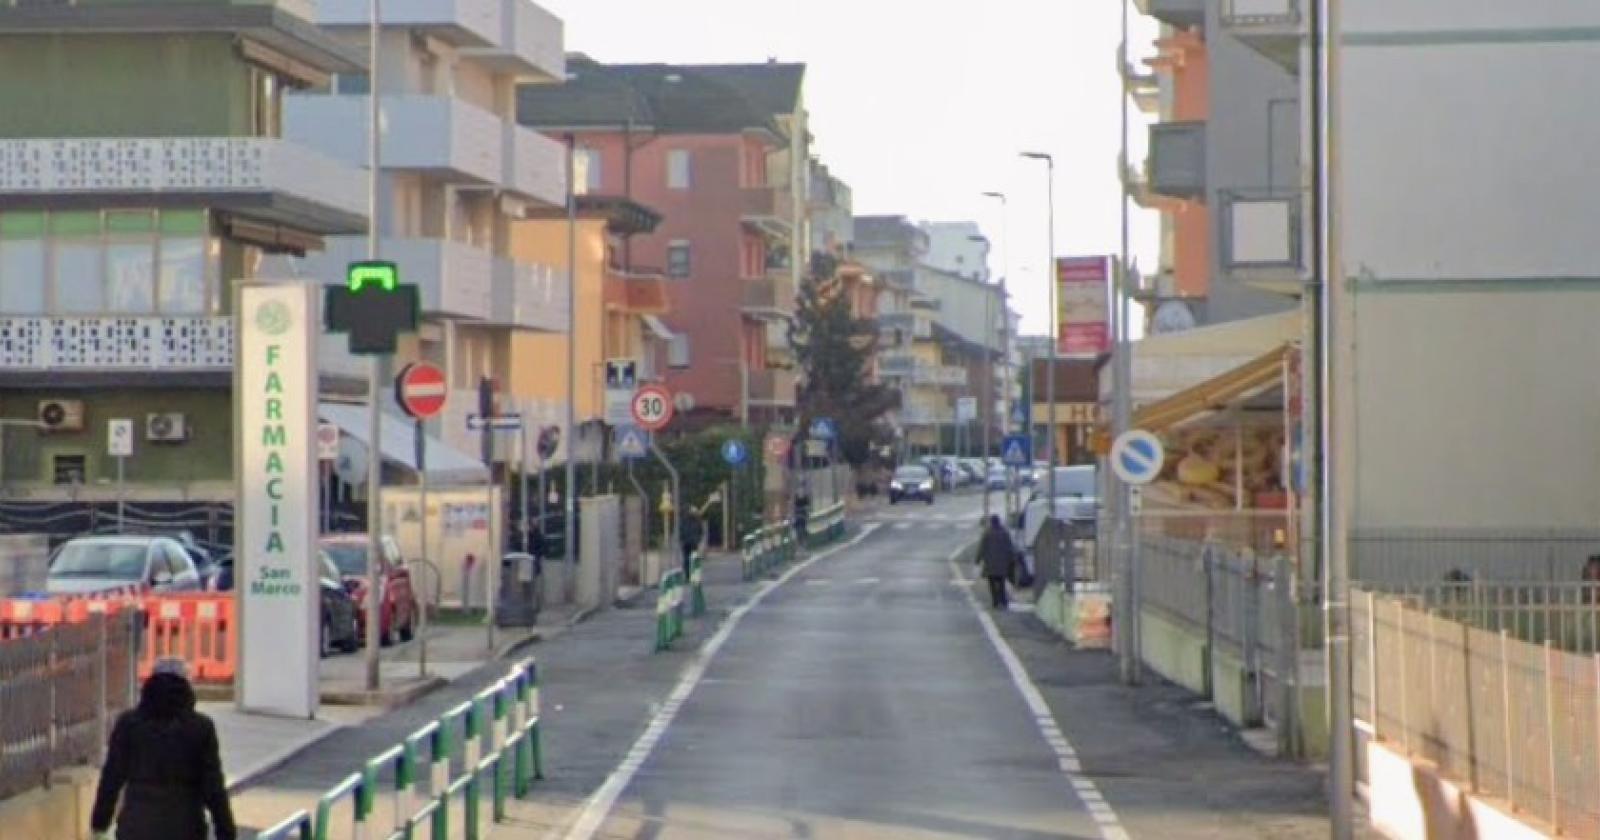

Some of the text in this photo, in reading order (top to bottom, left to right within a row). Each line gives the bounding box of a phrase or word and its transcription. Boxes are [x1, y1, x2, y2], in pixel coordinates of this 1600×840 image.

[640, 397, 663, 416] 30
[261, 345, 287, 553] FARMACIA
[259, 565, 291, 580] San
[250, 580, 301, 596] Marco
